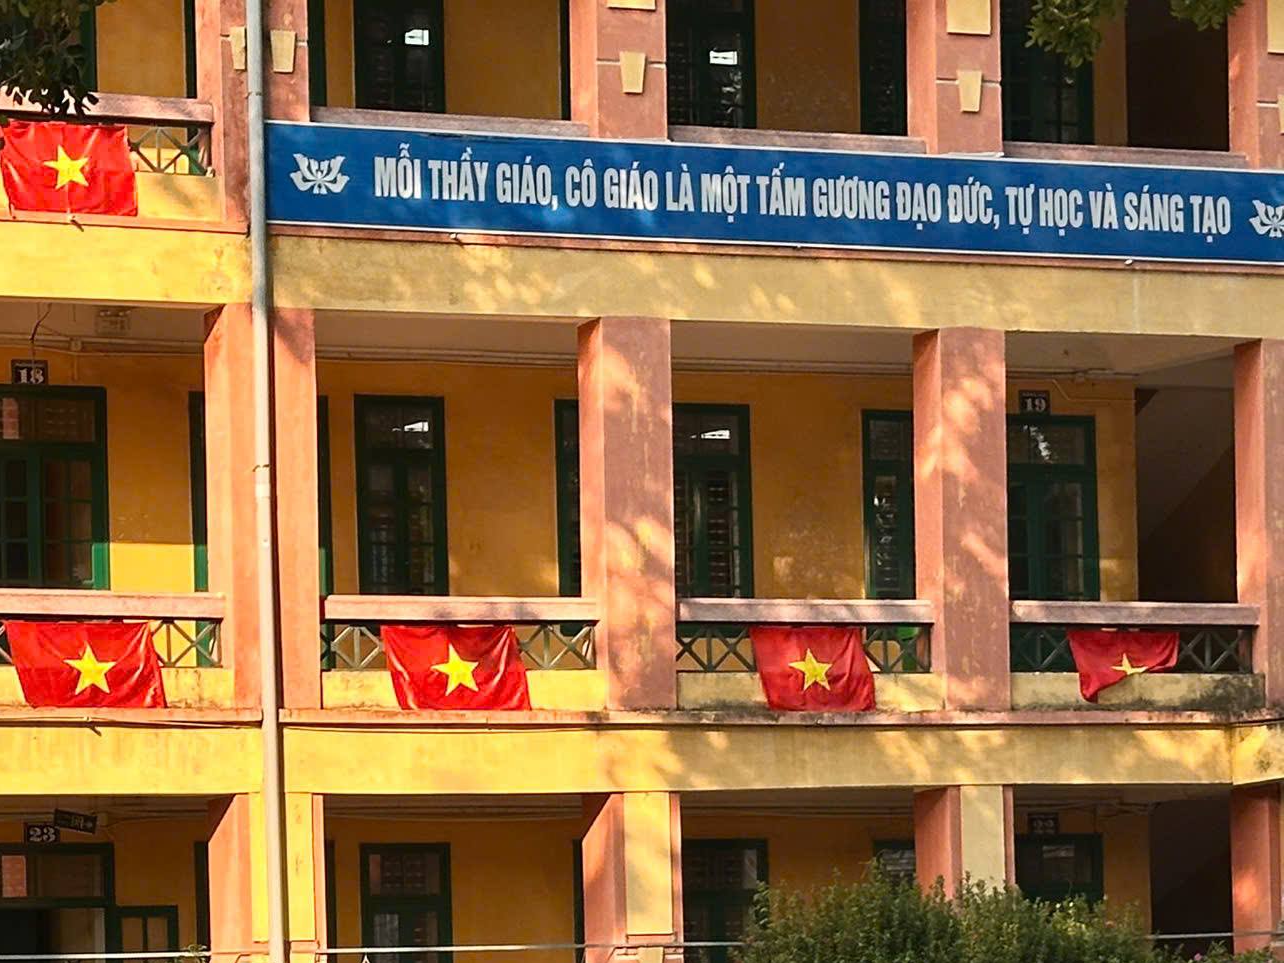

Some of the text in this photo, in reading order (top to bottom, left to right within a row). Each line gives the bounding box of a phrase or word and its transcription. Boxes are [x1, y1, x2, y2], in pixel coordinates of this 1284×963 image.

[374, 143, 1231, 243] MỖI THẦY GIÁO, CÔ GIÁO LÀ MỘT TẤM GƯƠNG ĐẠO ĐỨC, TỰ HỌC VÀ SÁNG TẠO
[1024, 397, 1046, 412] 19
[29, 826, 56, 842] 23
